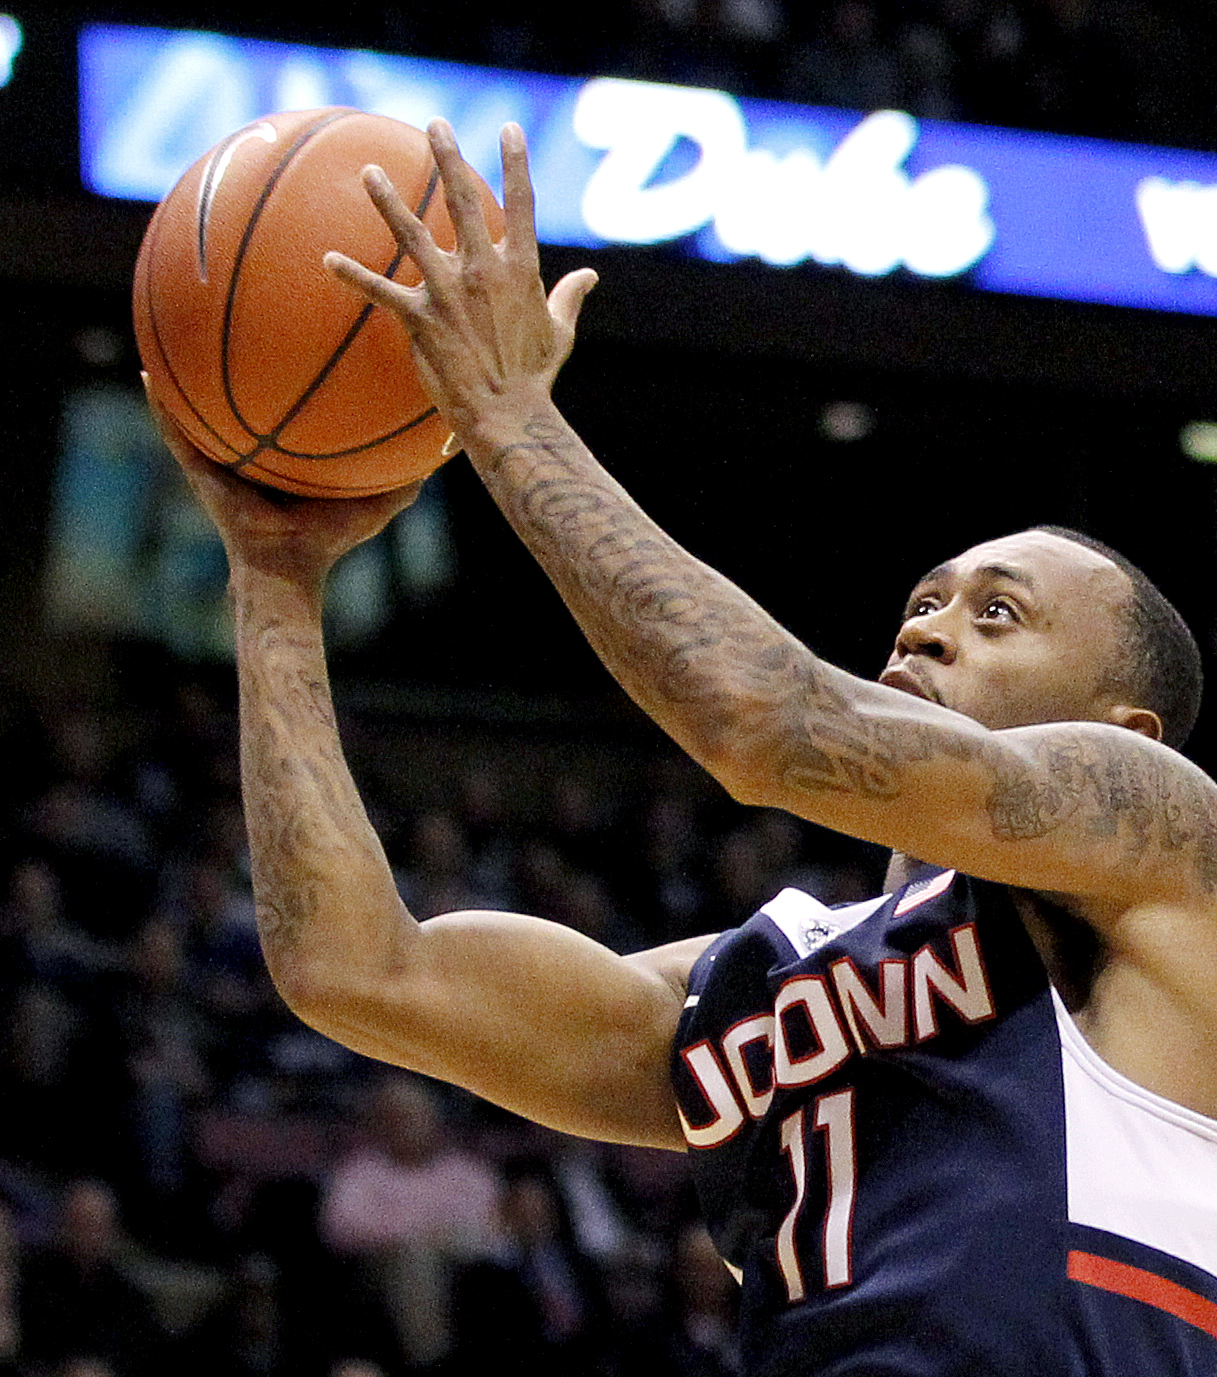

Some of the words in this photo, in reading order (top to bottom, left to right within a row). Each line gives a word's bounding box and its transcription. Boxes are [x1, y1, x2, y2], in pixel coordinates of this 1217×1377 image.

[573, 76, 996, 278] Duke
[675, 923, 995, 1148] UCONN
[778, 1089, 857, 1301] 11
